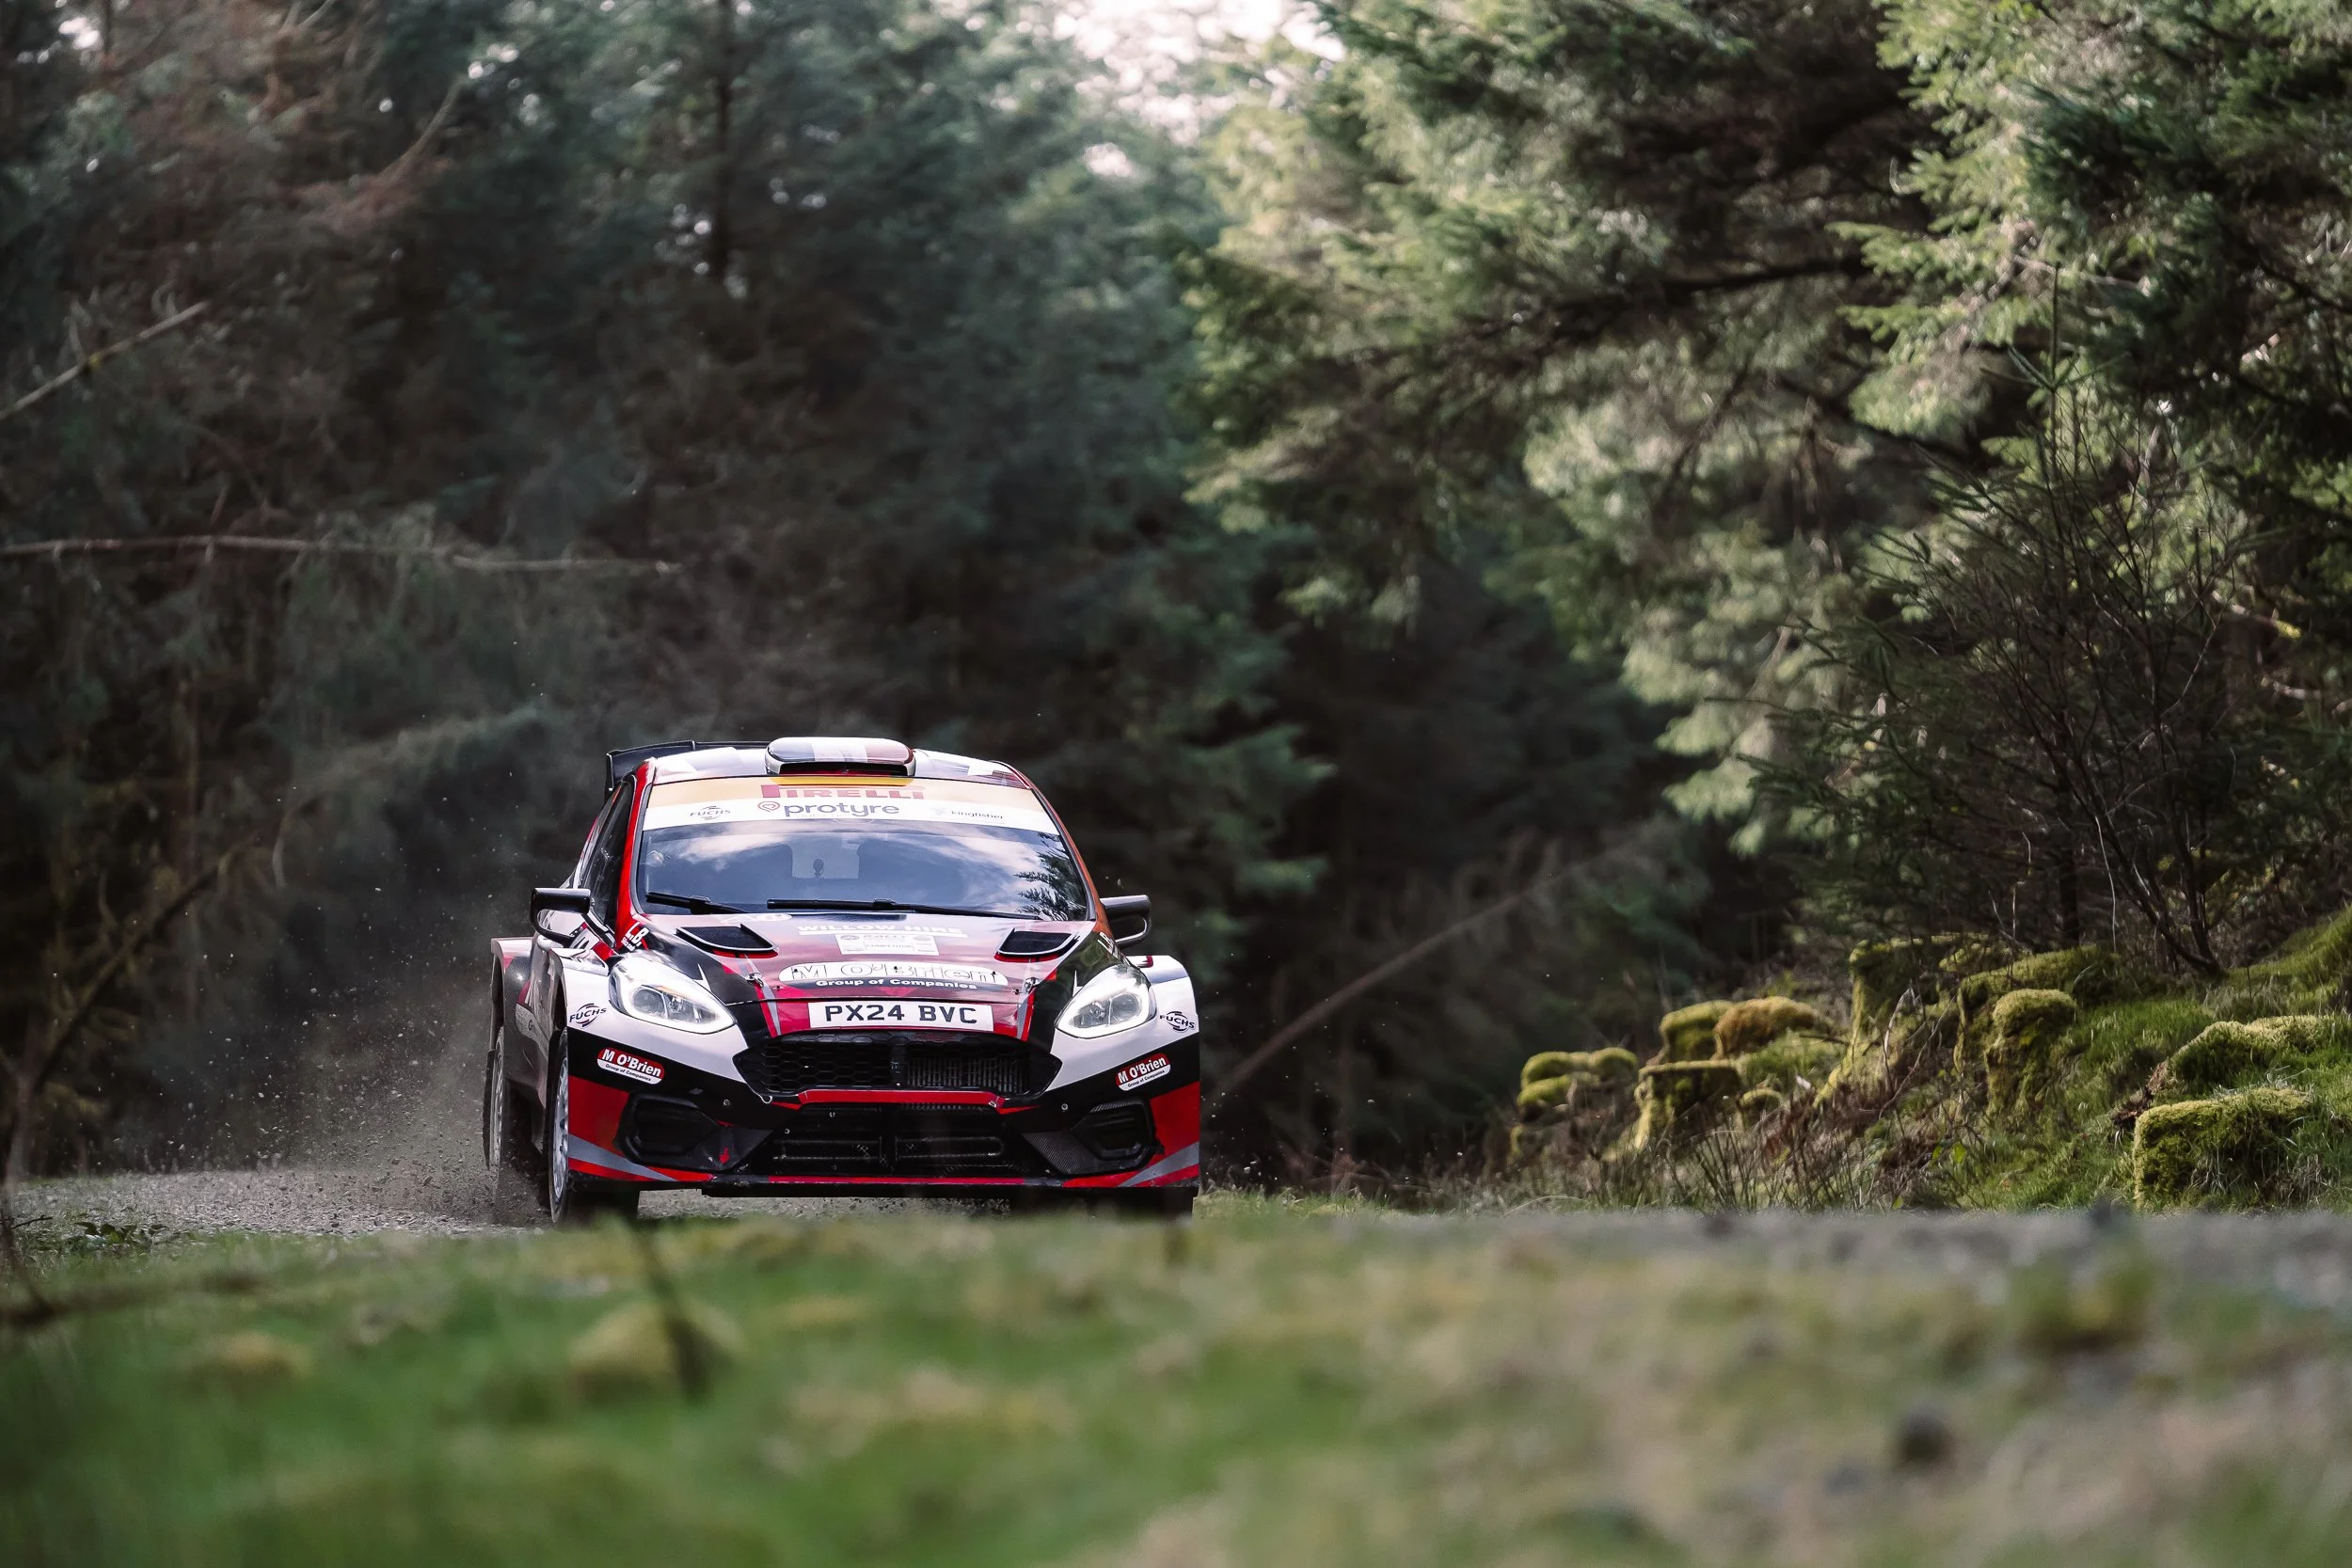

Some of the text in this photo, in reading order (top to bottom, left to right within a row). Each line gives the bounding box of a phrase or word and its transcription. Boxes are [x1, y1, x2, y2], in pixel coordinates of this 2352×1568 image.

[761, 784, 925, 800] PIRELLI
[784, 802, 899, 817] protyre
[791, 962, 997, 984] M O'Brien
[816, 978, 865, 987] Group
[890, 979, 977, 990] Companies
[569, 1007, 607, 1023] FUCHS
[825, 1005, 977, 1024] PX24 BVC
[1159, 1015, 1195, 1029] FUCHS
[601, 1049, 661, 1077] M O'Brien
[605, 1064, 620, 1072] Group
[1118, 1057, 1167, 1084] M O'Brien
[1127, 1080, 1140, 1088] Group
